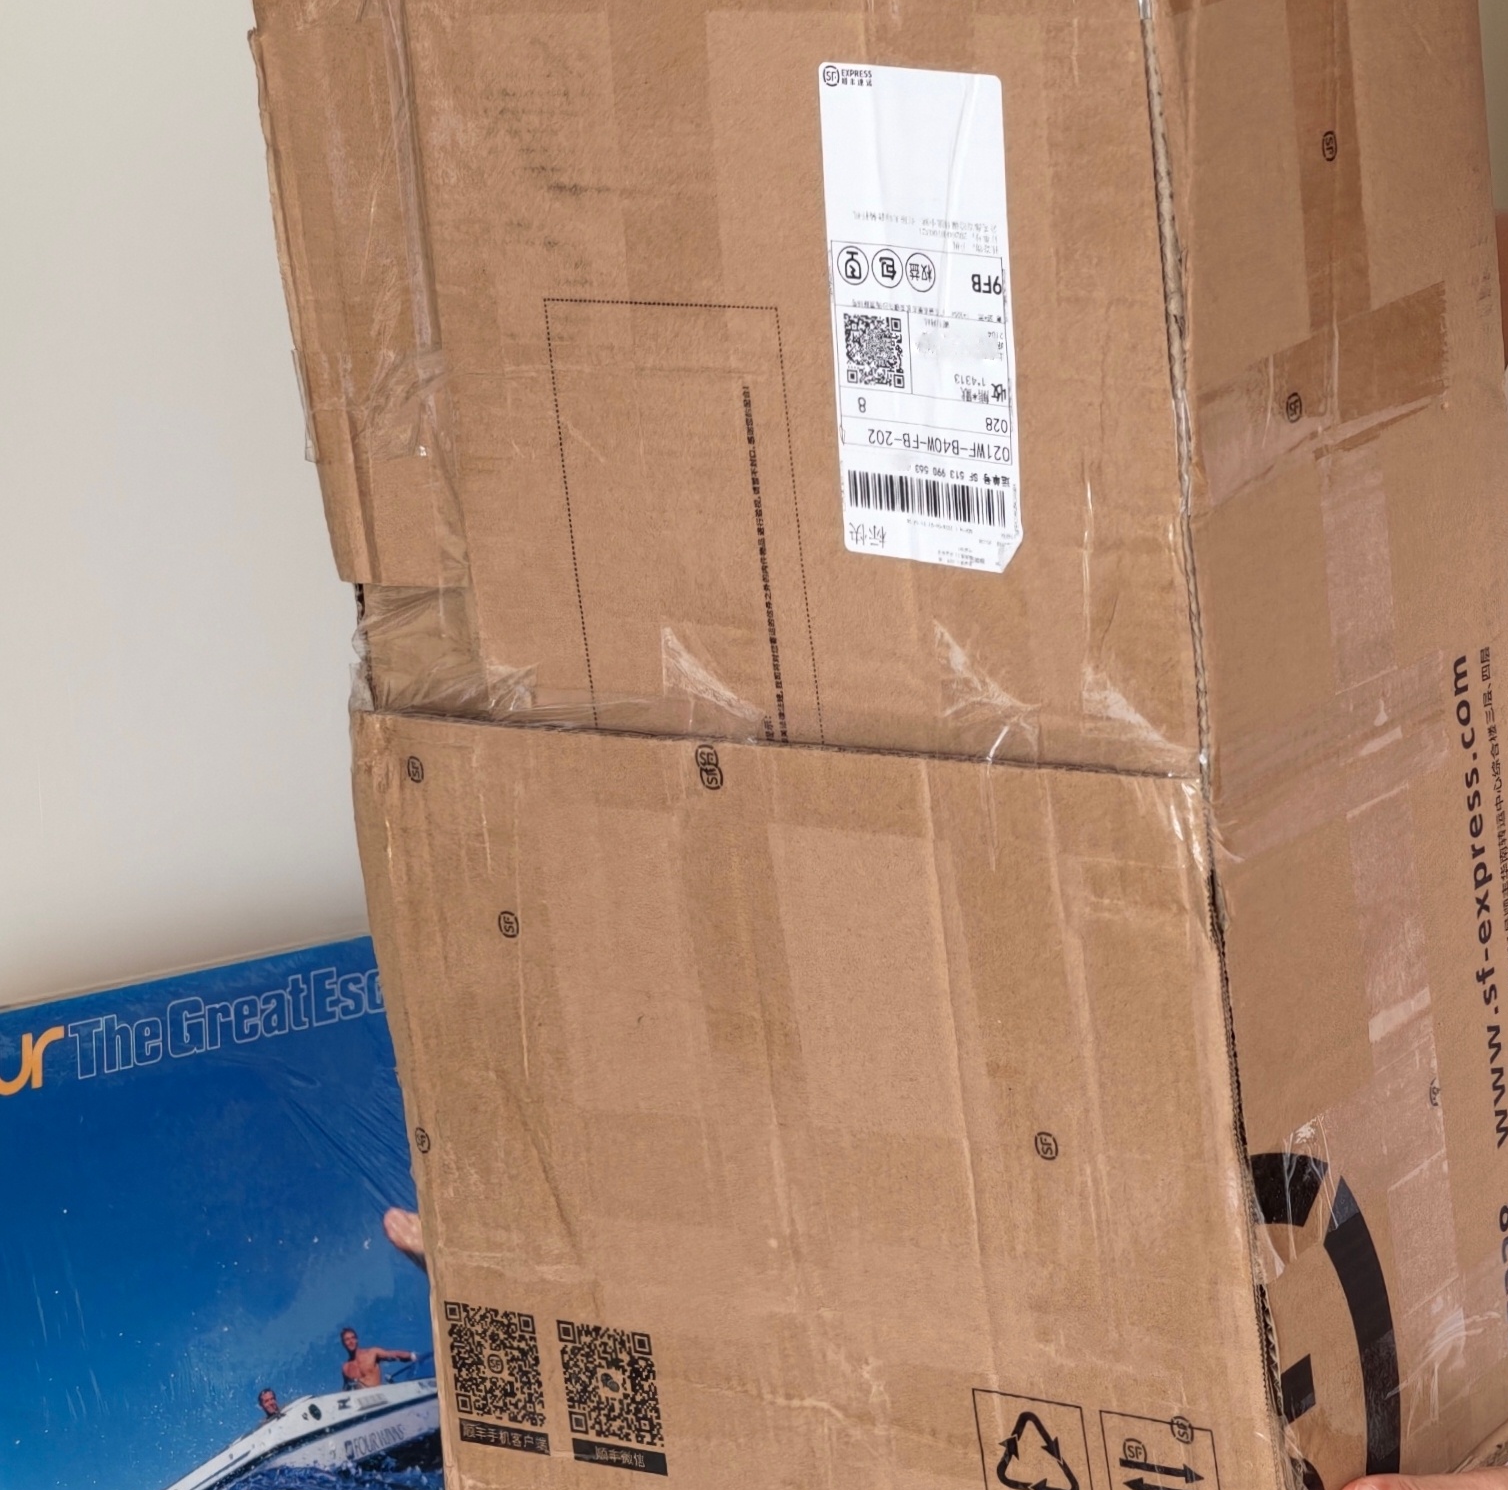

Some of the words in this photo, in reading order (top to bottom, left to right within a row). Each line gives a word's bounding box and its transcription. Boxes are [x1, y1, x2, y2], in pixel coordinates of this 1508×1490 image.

[841, 69, 873, 78] EXPRESS
[970, 273, 1002, 295] 9FB
[990, 383, 1007, 403] 收
[857, 396, 867, 414] 8
[984, 417, 1008, 434] 028
[867, 428, 1010, 462] 021WF-B40W-FB-202
[914, 464, 929, 477] 563
[932, 466, 947, 479] 990
[949, 469, 965, 481] 513
[968, 471, 979, 482] SF
[68, 1013, 163, 1080] The
[167, 973, 309, 1059] Great
